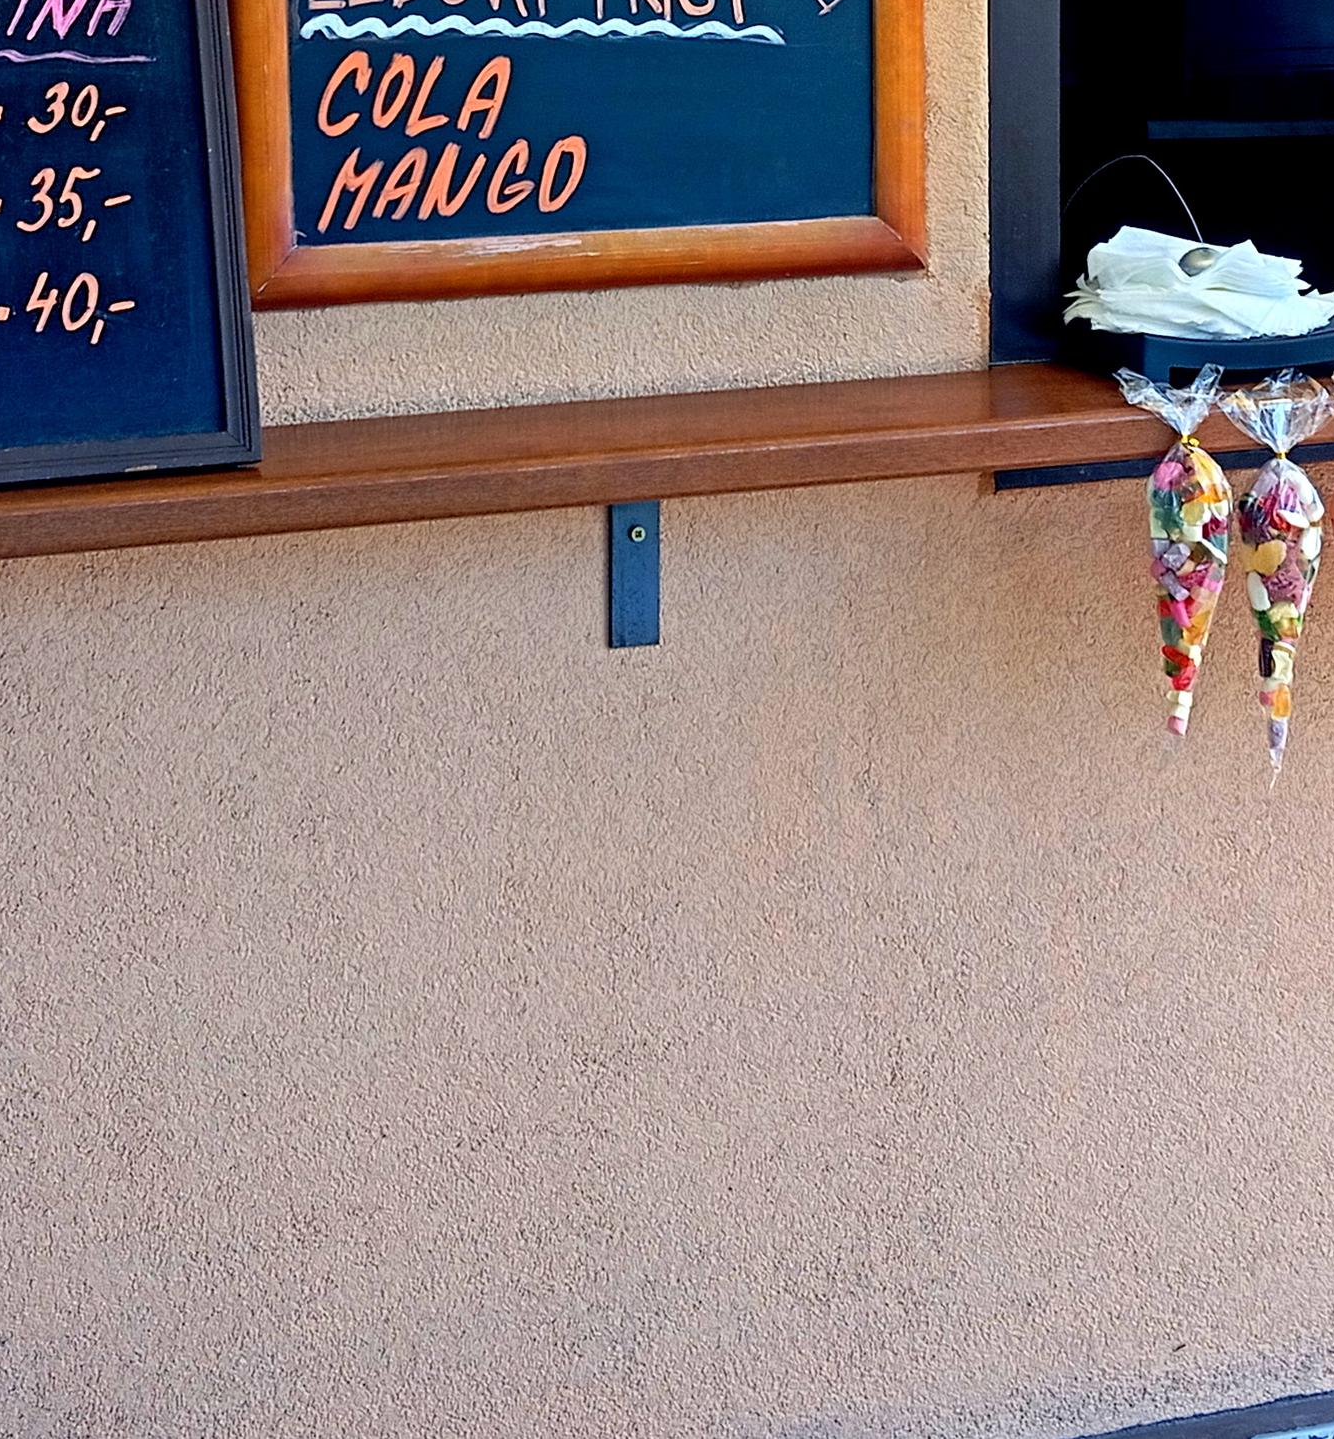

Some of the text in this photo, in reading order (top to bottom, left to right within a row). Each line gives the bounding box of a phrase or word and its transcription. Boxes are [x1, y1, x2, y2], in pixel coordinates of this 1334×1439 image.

[26, 81, 128, 143] 30,-
[317, 50, 512, 140] COLA
[15, 166, 133, 242] 35,-
[318, 135, 587, 234] MANGO
[25, 270, 137, 345] 40,-
